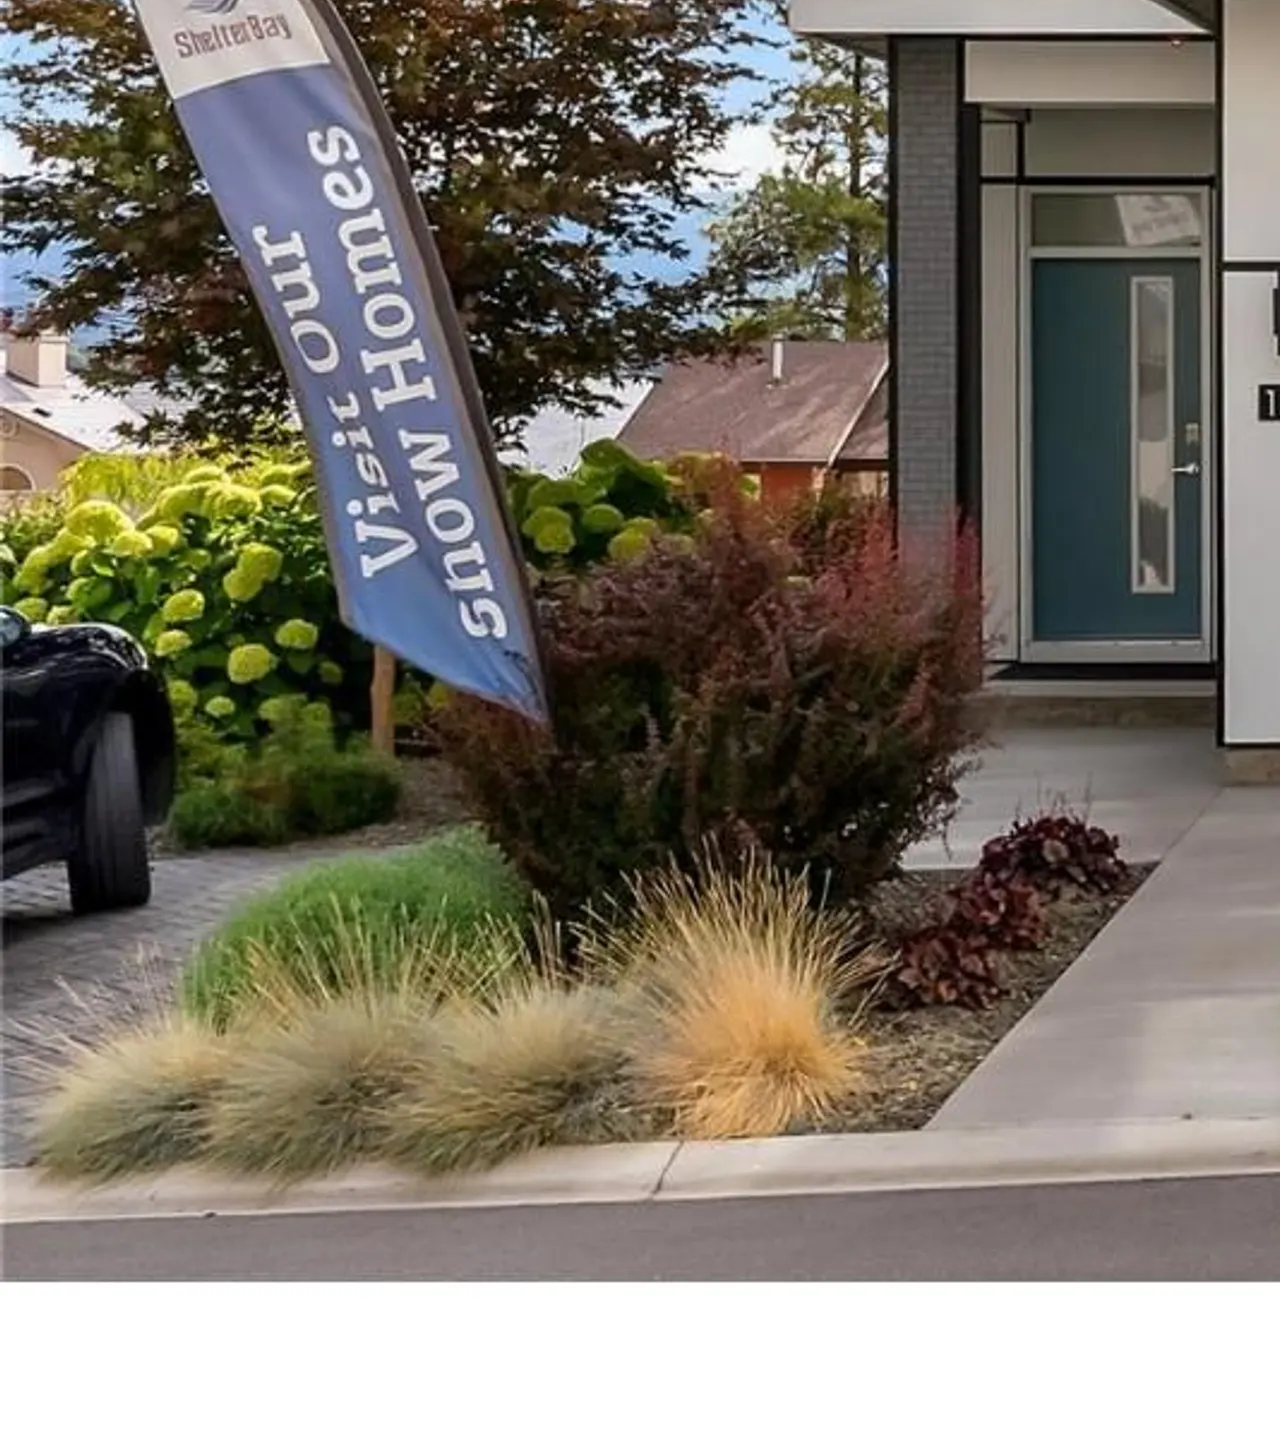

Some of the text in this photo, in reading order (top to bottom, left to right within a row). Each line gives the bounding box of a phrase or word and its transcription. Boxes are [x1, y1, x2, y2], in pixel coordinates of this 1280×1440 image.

[252, 224, 419, 578] Visit Our
[307, 125, 437, 412] Homes
